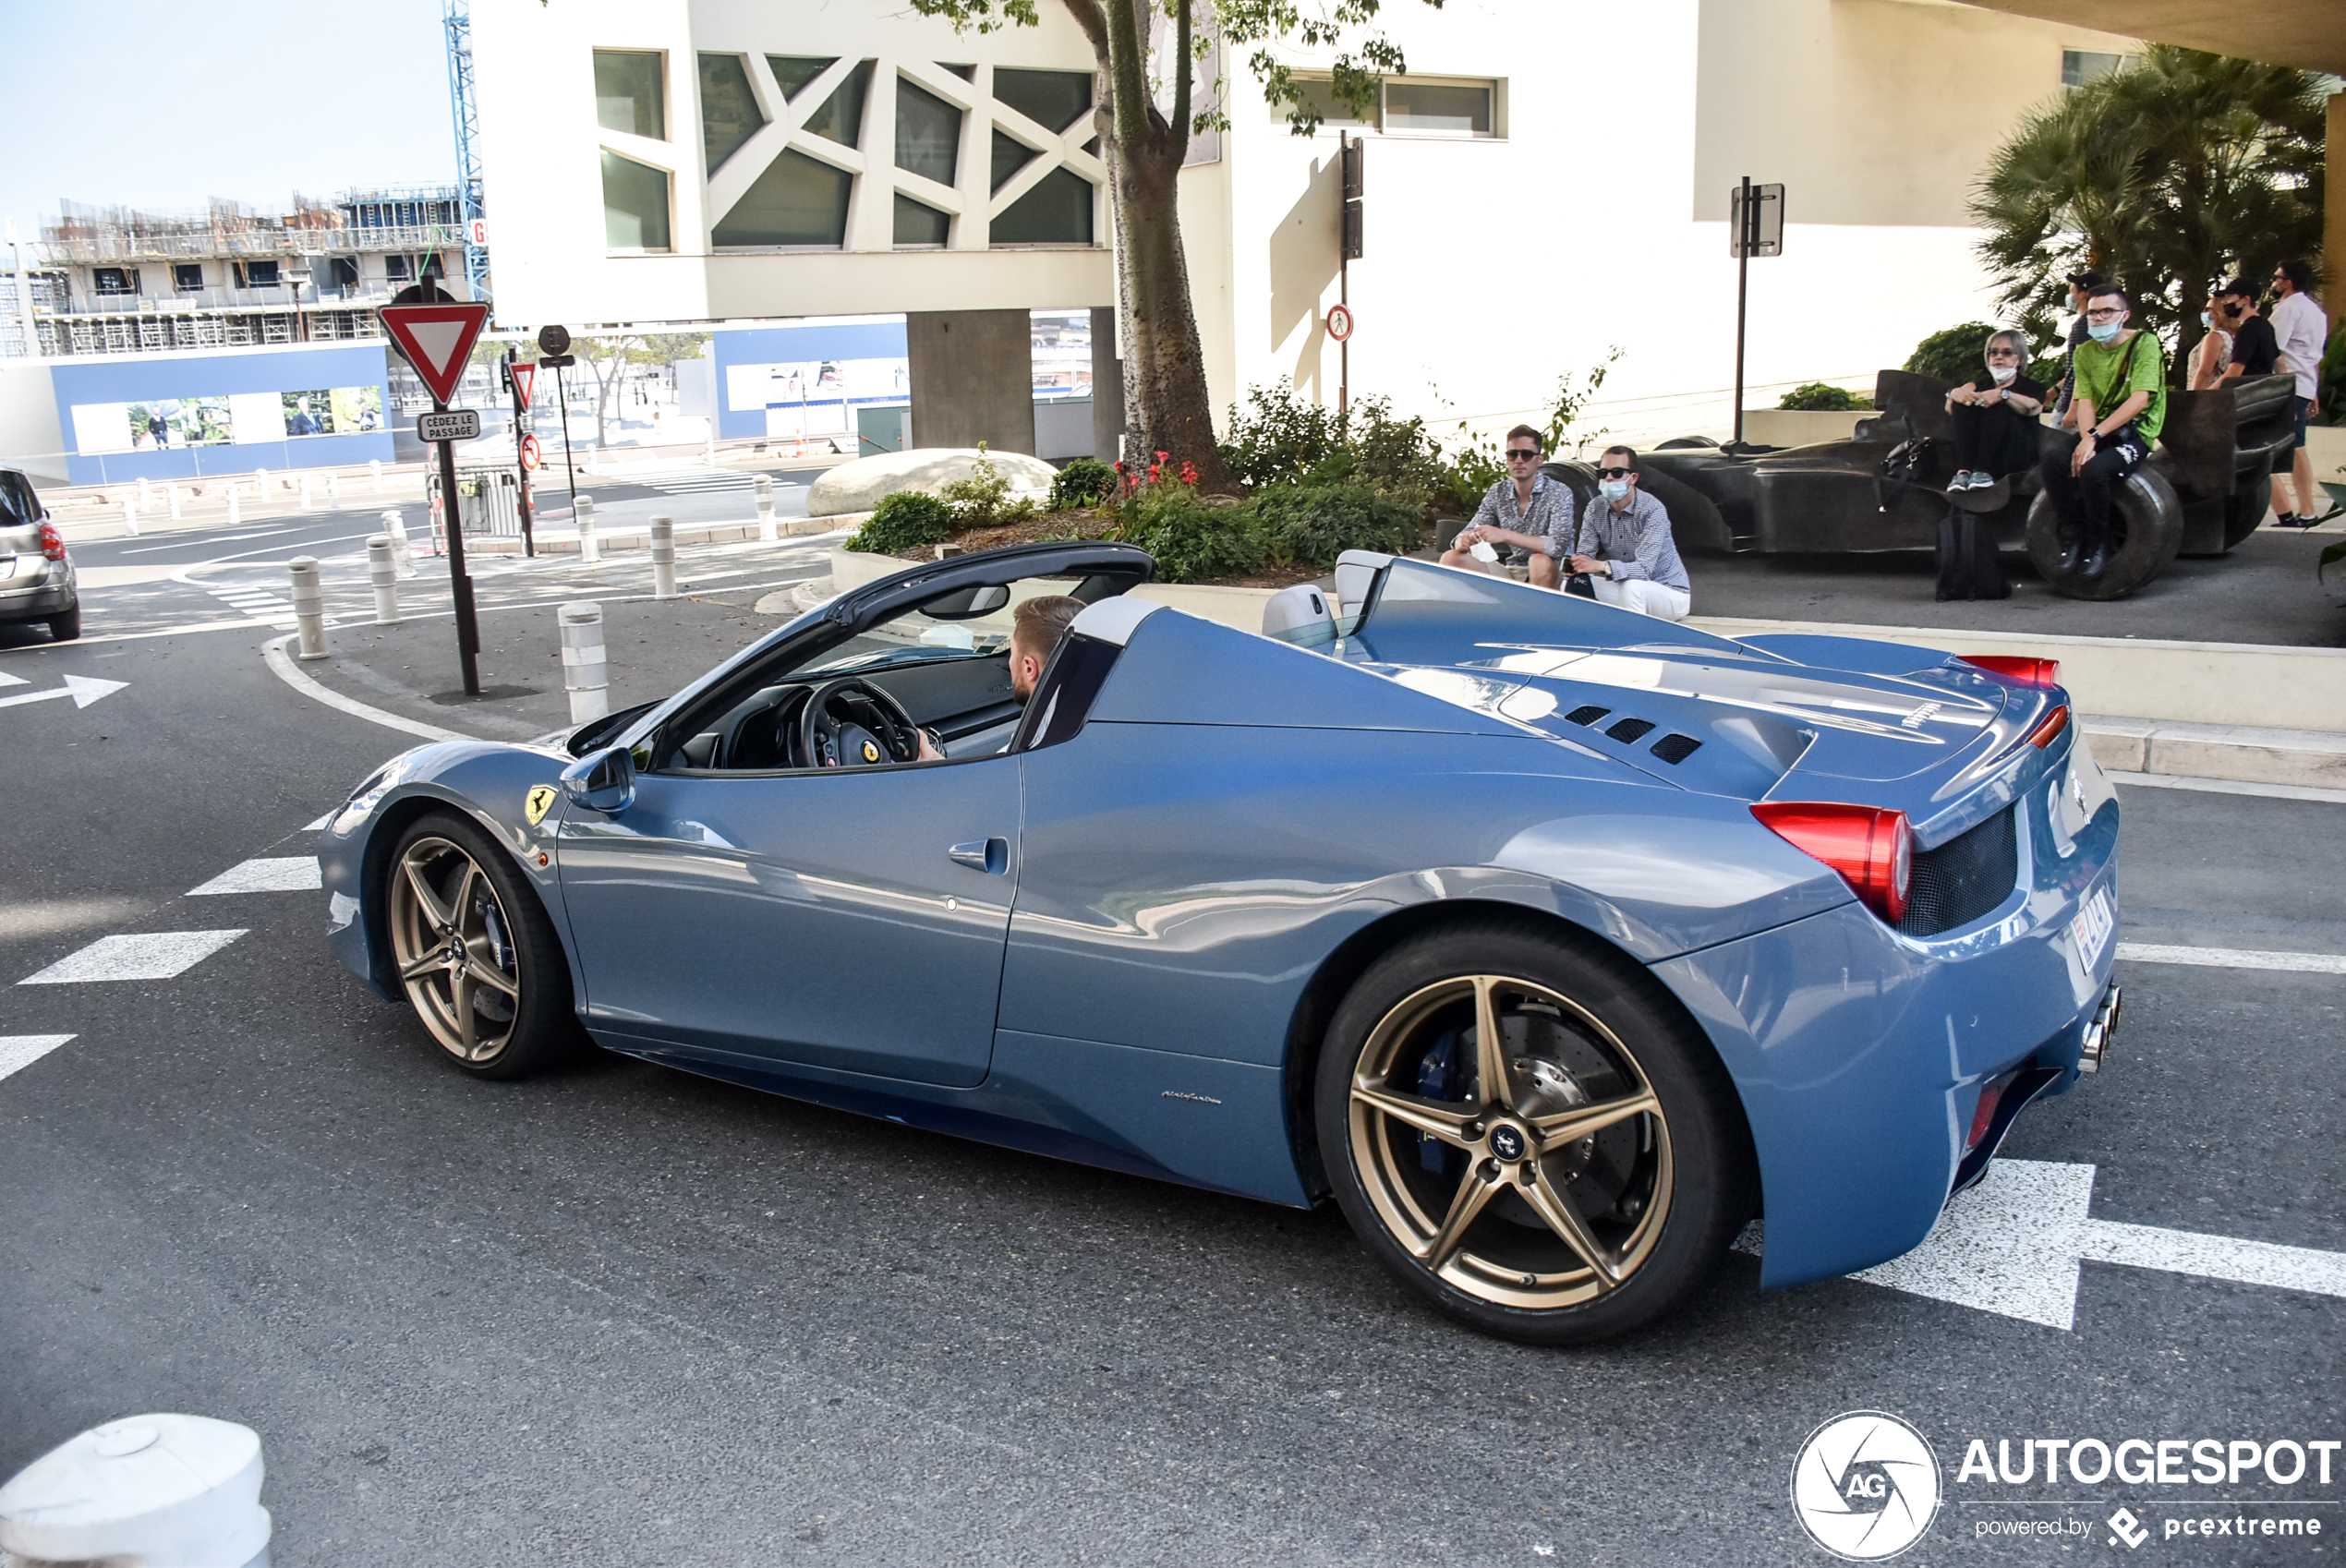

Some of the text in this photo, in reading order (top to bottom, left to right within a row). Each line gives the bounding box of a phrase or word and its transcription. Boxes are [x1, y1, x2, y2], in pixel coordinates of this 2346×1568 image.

[475, 223, 485, 243] G
[427, 415, 473, 428] CÉDEZ LE
[429, 426, 473, 439] PASSAGE
